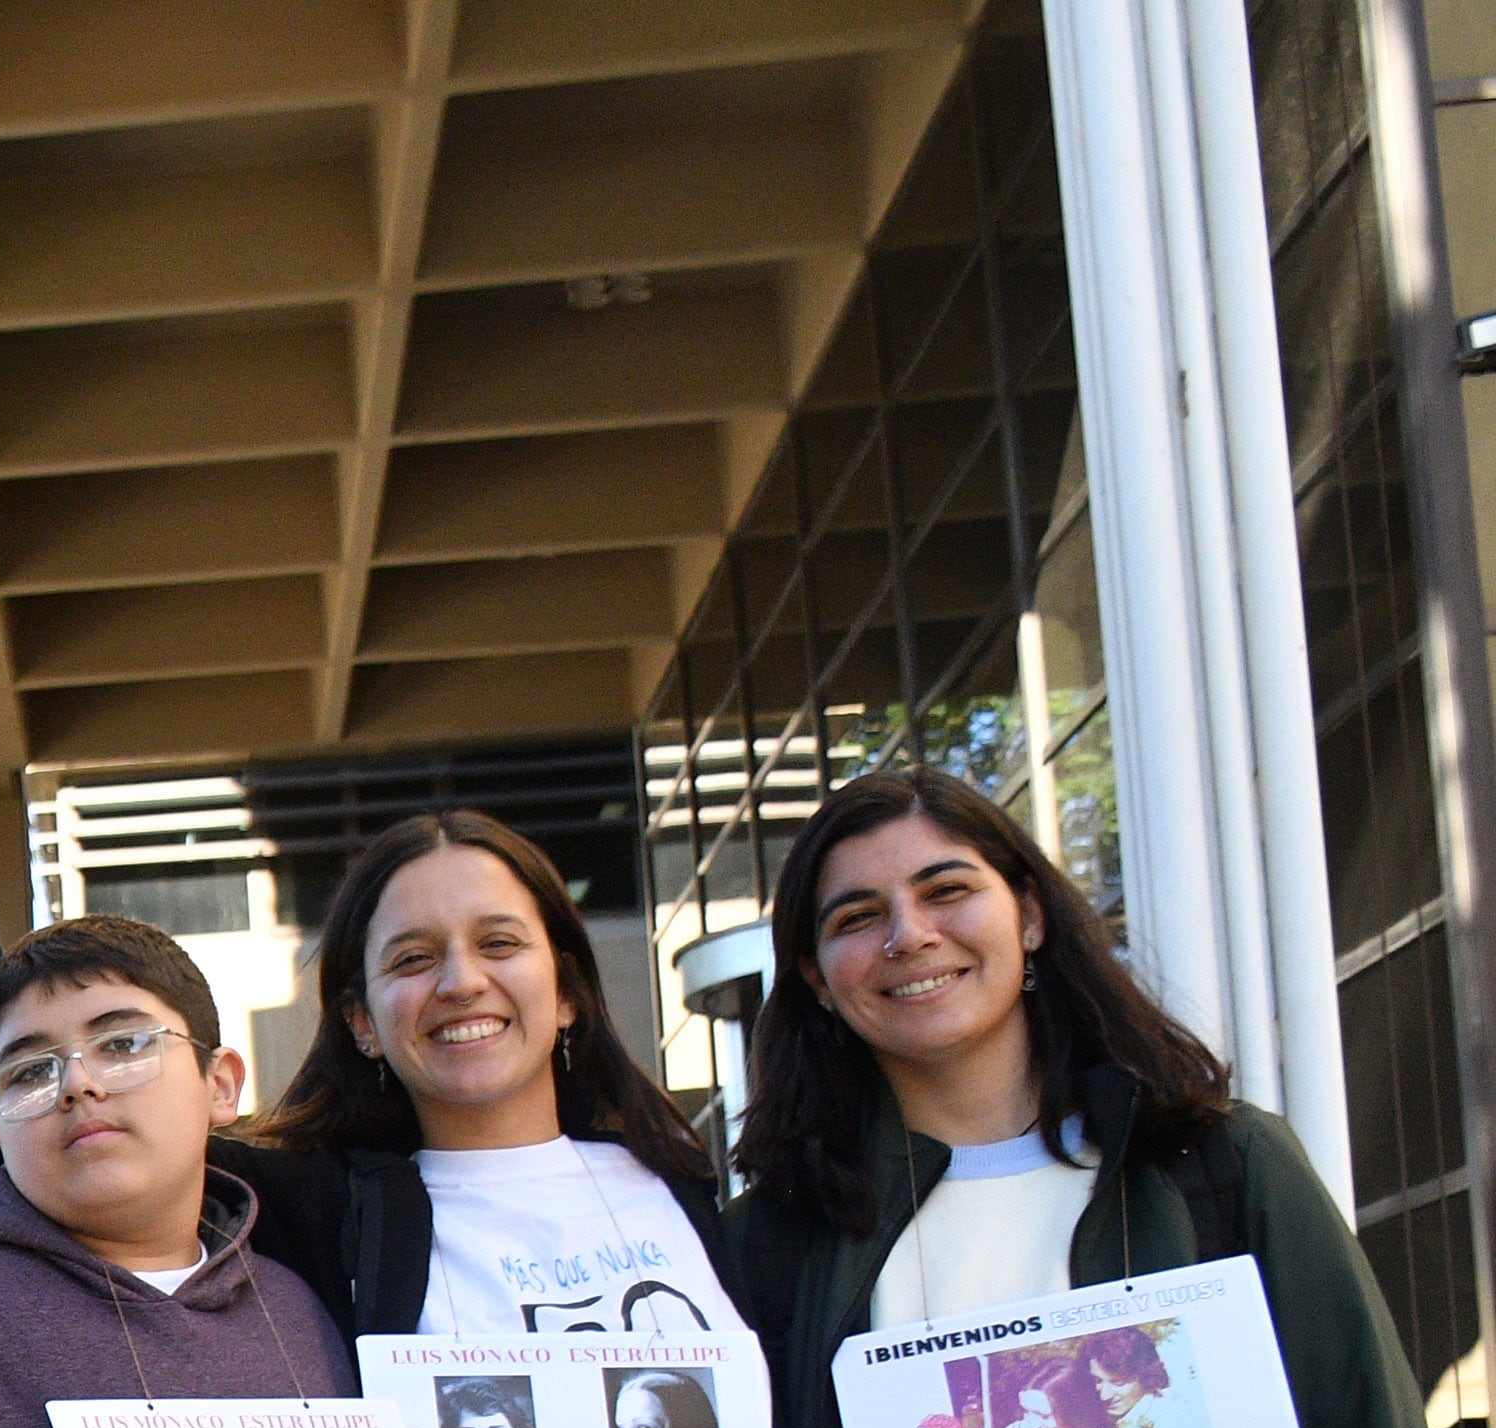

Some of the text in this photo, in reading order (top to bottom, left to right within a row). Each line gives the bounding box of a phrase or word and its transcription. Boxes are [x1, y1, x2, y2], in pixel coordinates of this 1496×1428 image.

[499, 1239, 672, 1293] MÁS QUE NUNCA
[864, 1279, 1225, 1365] ¡BIENVENIDOS ESTER Y LUIS!
[392, 1345, 730, 1364] LUIS MÓNACO ESTER FELIPE
